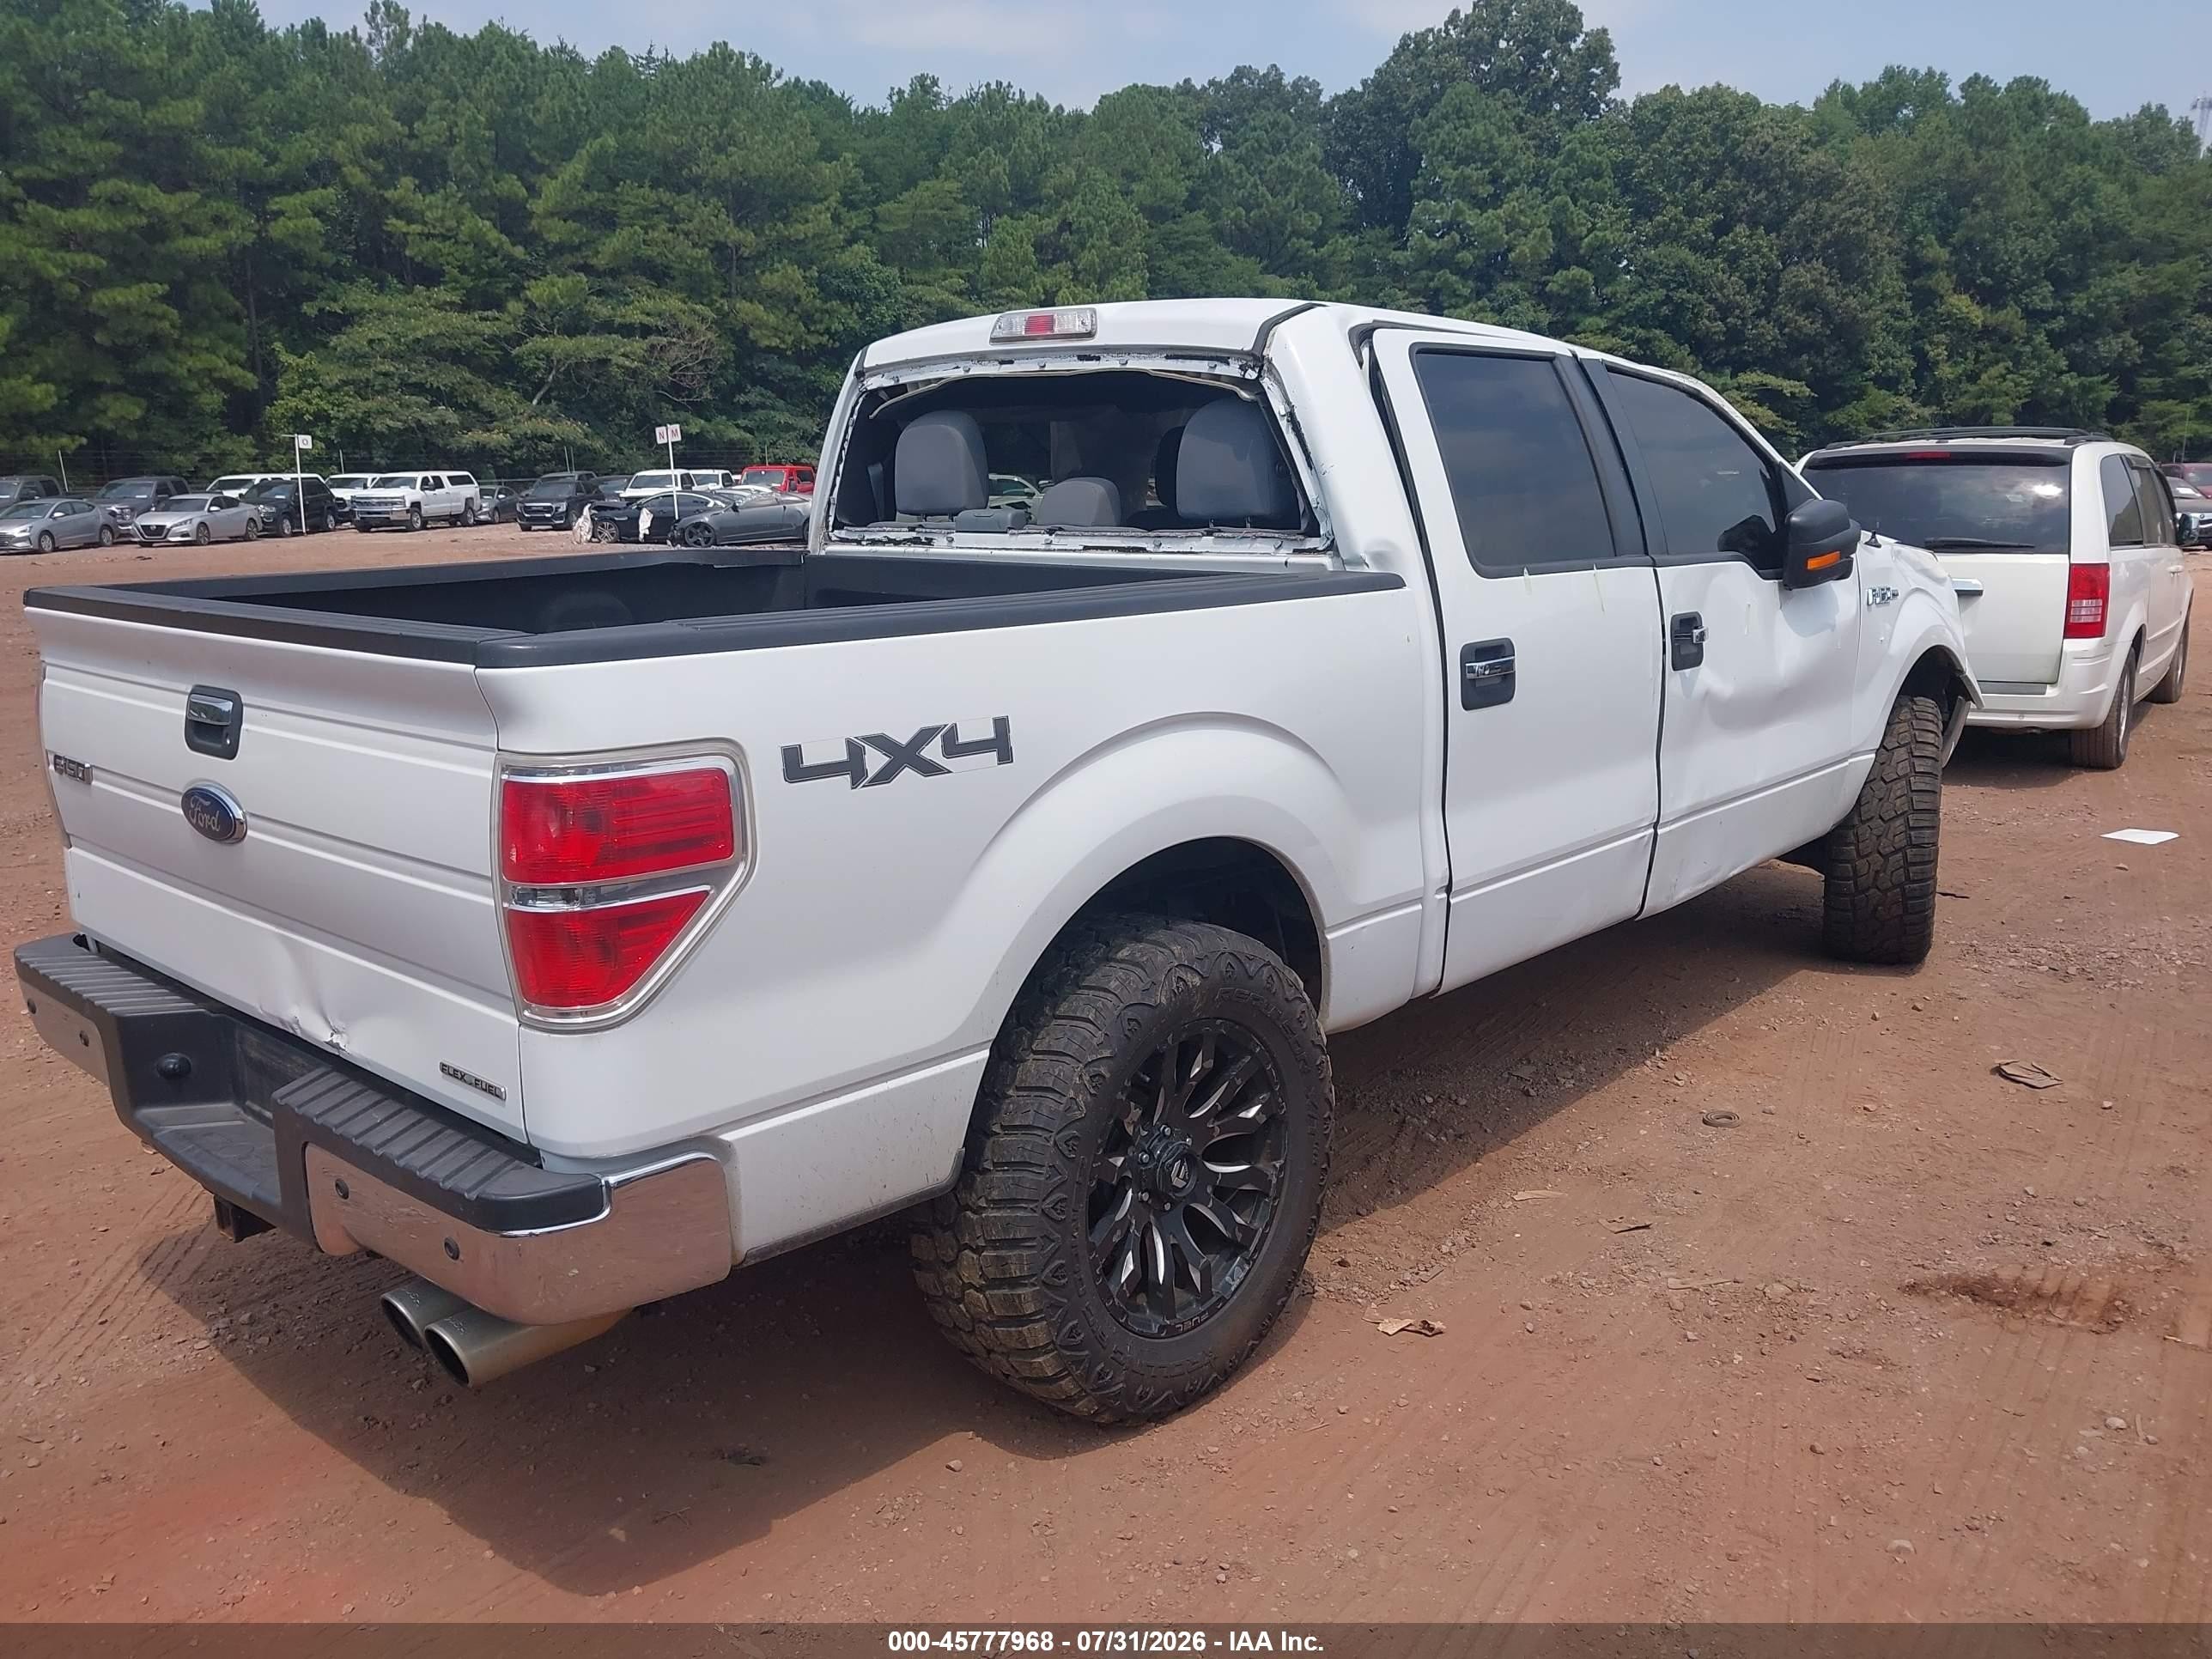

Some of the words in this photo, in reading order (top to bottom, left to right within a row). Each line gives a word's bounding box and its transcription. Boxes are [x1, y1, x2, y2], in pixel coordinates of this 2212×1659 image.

[659, 430, 665, 441] N
[671, 428, 679, 438] M
[189, 795, 221, 832] Ford
[441, 1062, 467, 1084] FLEX
[474, 1077, 503, 1100] FUEL
[1175, 1311, 1209, 1332] FUEL
